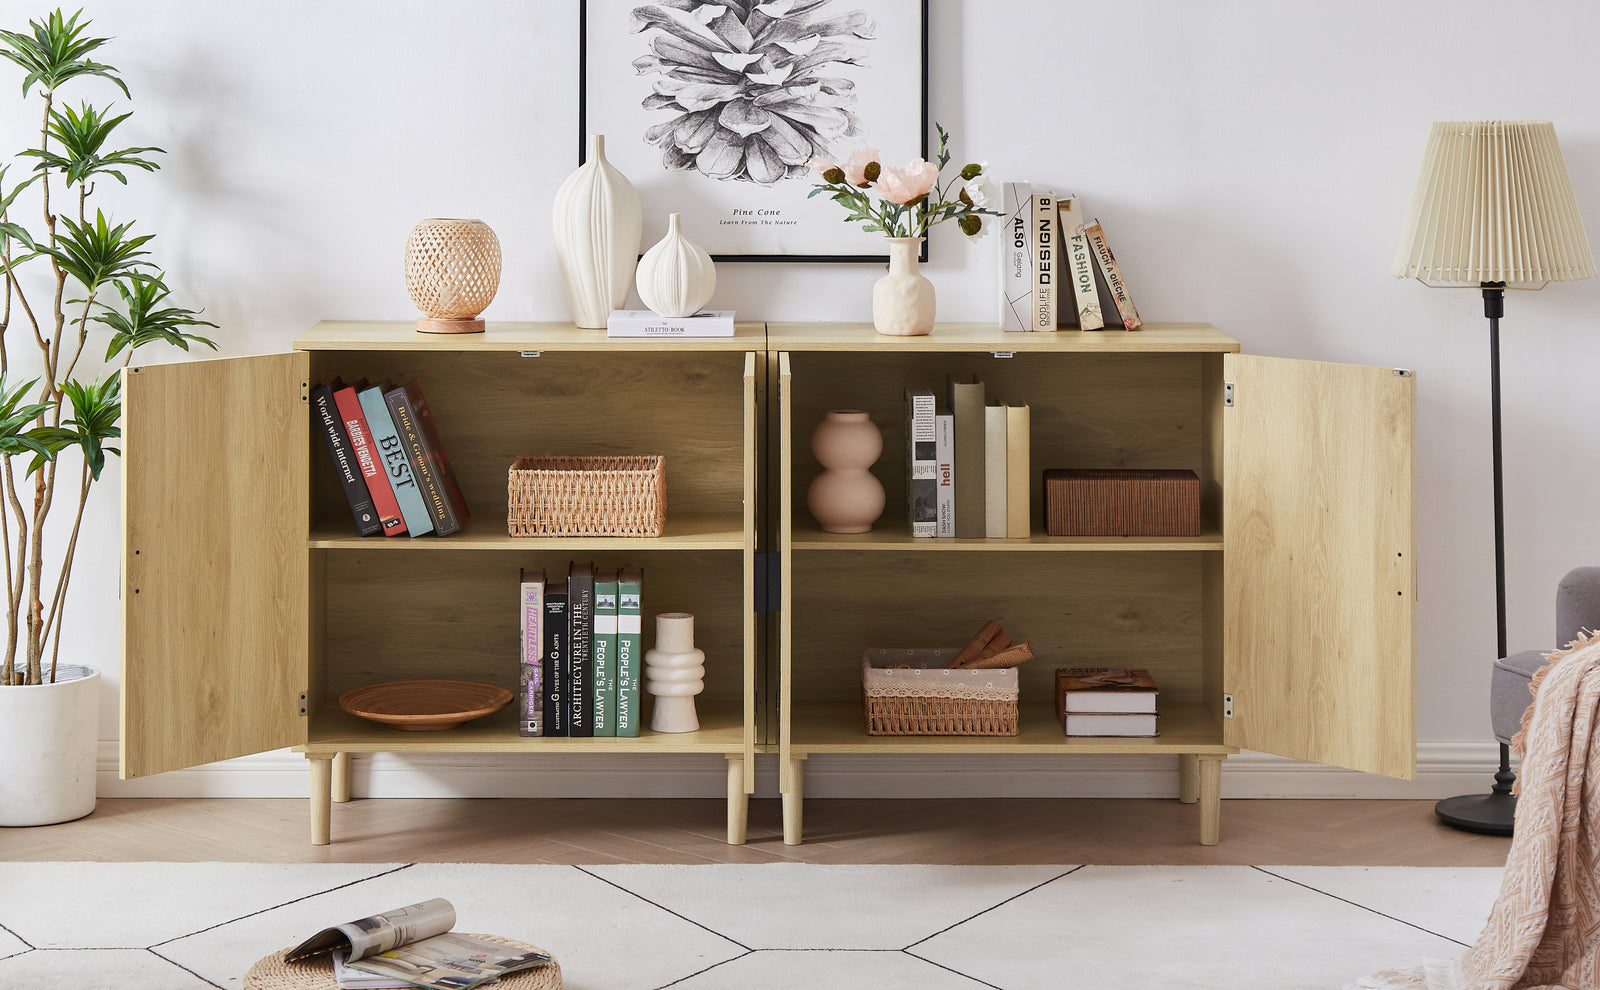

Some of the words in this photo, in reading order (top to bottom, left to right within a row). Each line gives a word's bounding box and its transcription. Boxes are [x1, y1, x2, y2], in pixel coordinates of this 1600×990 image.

[732, 208, 753, 216] Pine
[757, 208, 781, 216] Cone
[1039, 198, 1051, 212] 18
[1014, 217, 1024, 248] ALSO
[1039, 219, 1051, 285] DESIGN
[1071, 235, 1092, 294] FASHION
[1094, 236, 1111, 266] FIAUCH
[1106, 264, 1114, 274] A
[1039, 288, 1047, 327] OODLIFE
[398, 406, 412, 432] Bride
[408, 433, 417, 441] &
[316, 395, 334, 426] World
[329, 425, 340, 448] wide
[336, 447, 356, 484] internet
[346, 419, 365, 446] BARBIES
[356, 445, 377, 478] VENDETTA
[379, 434, 415, 490] BEST
[412, 443, 431, 483] Groom's
[941, 463, 951, 487] hell
[428, 483, 446, 521] wedding
[573, 603, 582, 627] THE
[573, 628, 582, 641] IN
[527, 607, 538, 664] HEARTLESS
[554, 671, 560, 679] OF
[596, 640, 607, 687] PEOPLE'S
[620, 640, 631, 687] PEOPLE'S
[573, 642, 582, 728] ARCHITECYURE
[595, 688, 606, 729] LAWYER
[619, 688, 630, 729] LAWYER
